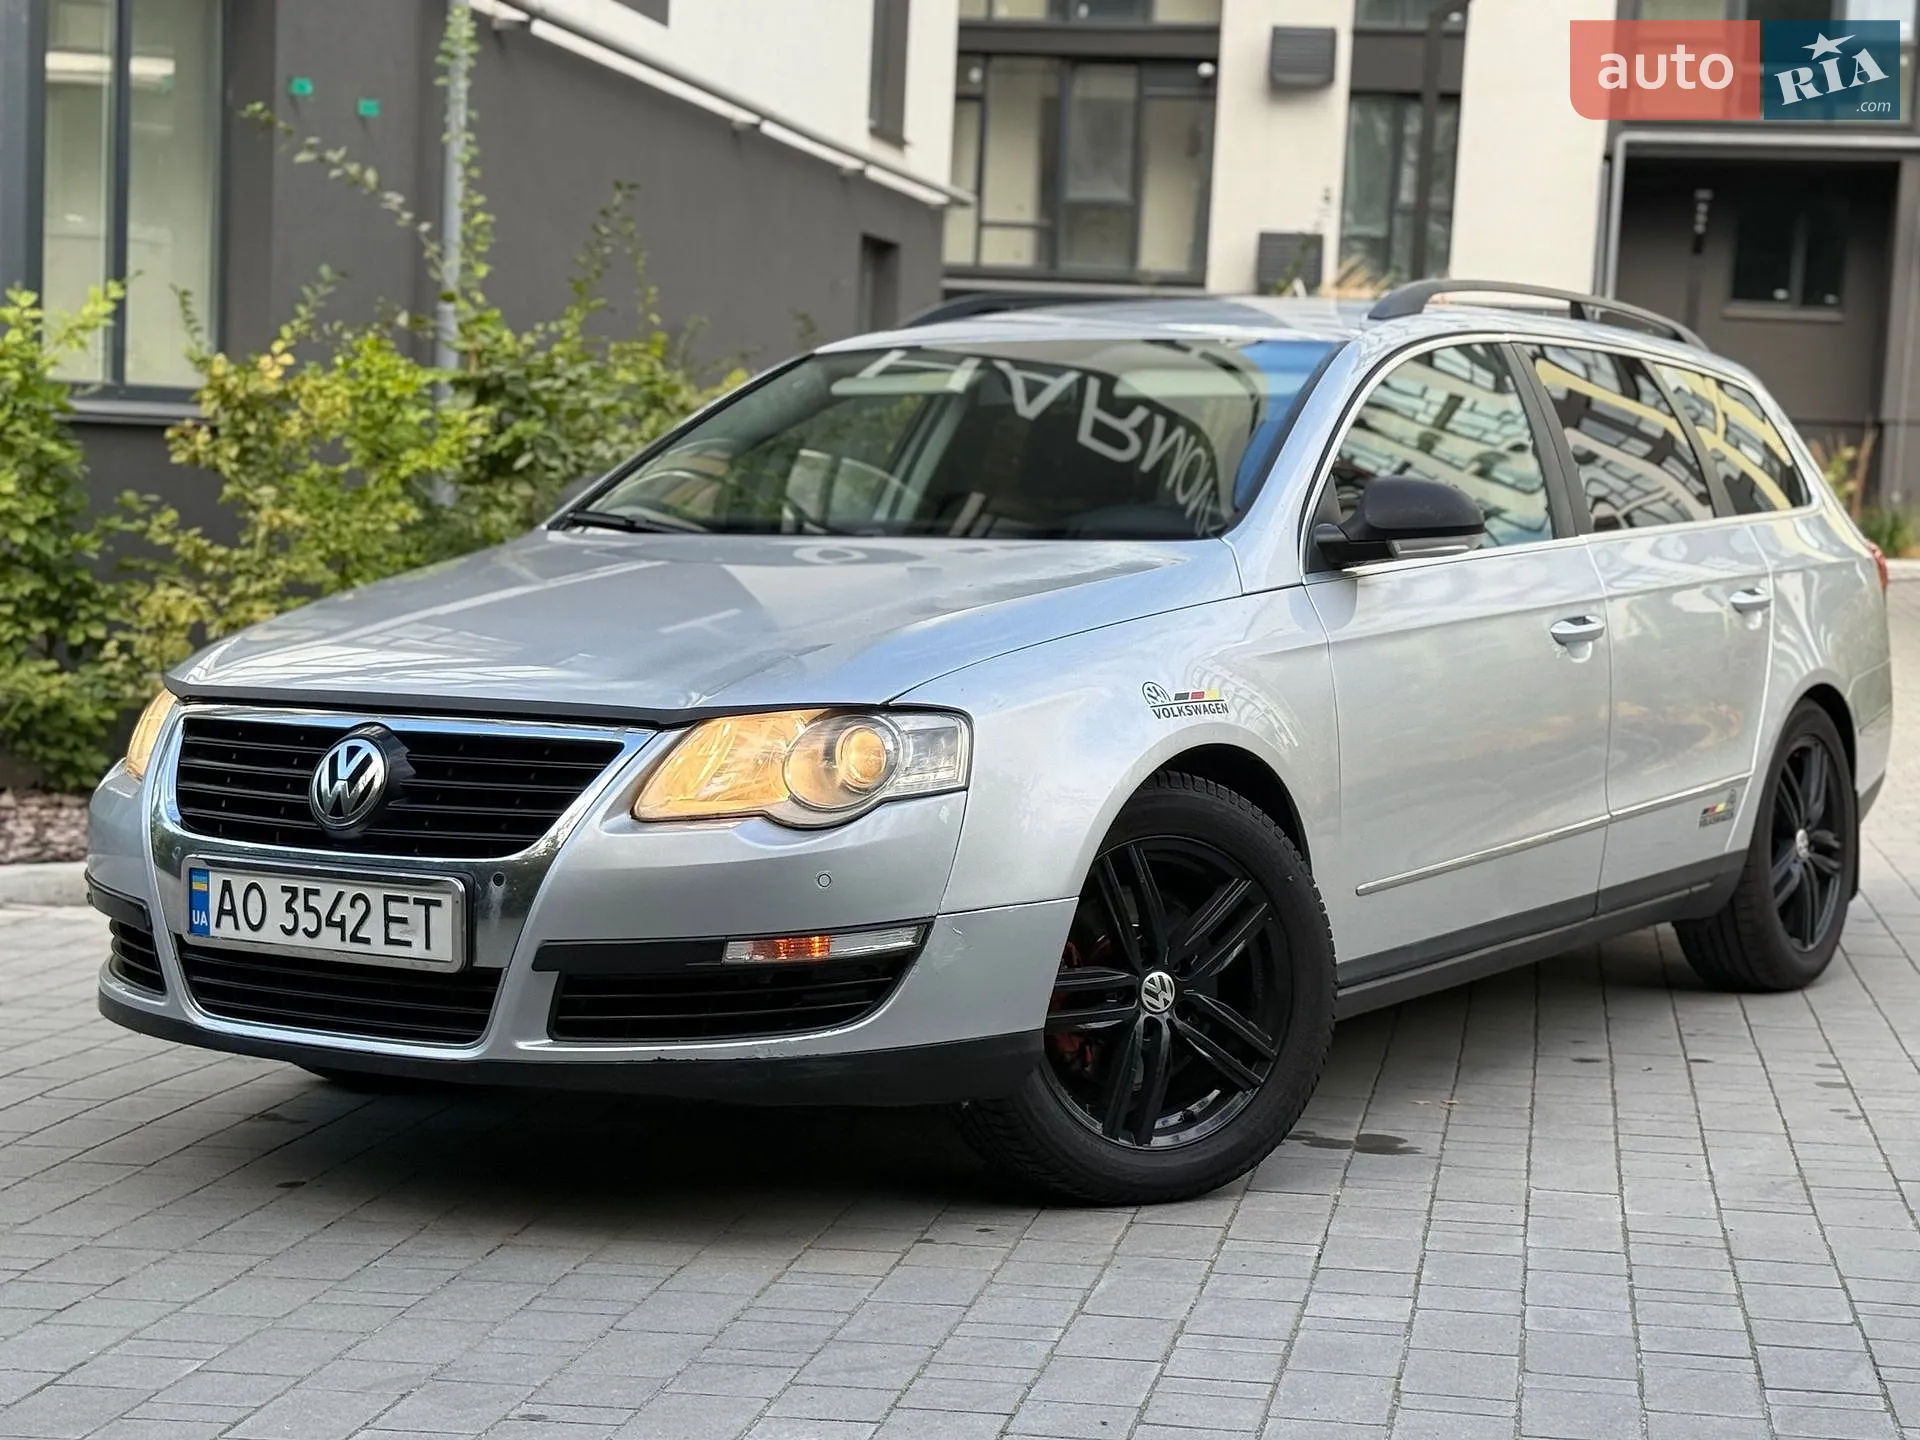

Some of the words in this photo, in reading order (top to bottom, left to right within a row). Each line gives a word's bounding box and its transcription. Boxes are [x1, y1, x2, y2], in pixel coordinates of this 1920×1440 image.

[1152, 702, 1230, 720] VOLKSWAGEN
[192, 909, 208, 927] UA
[215, 879, 267, 932] AO
[280, 885, 371, 944] 3542
[383, 894, 442, 950] ET
